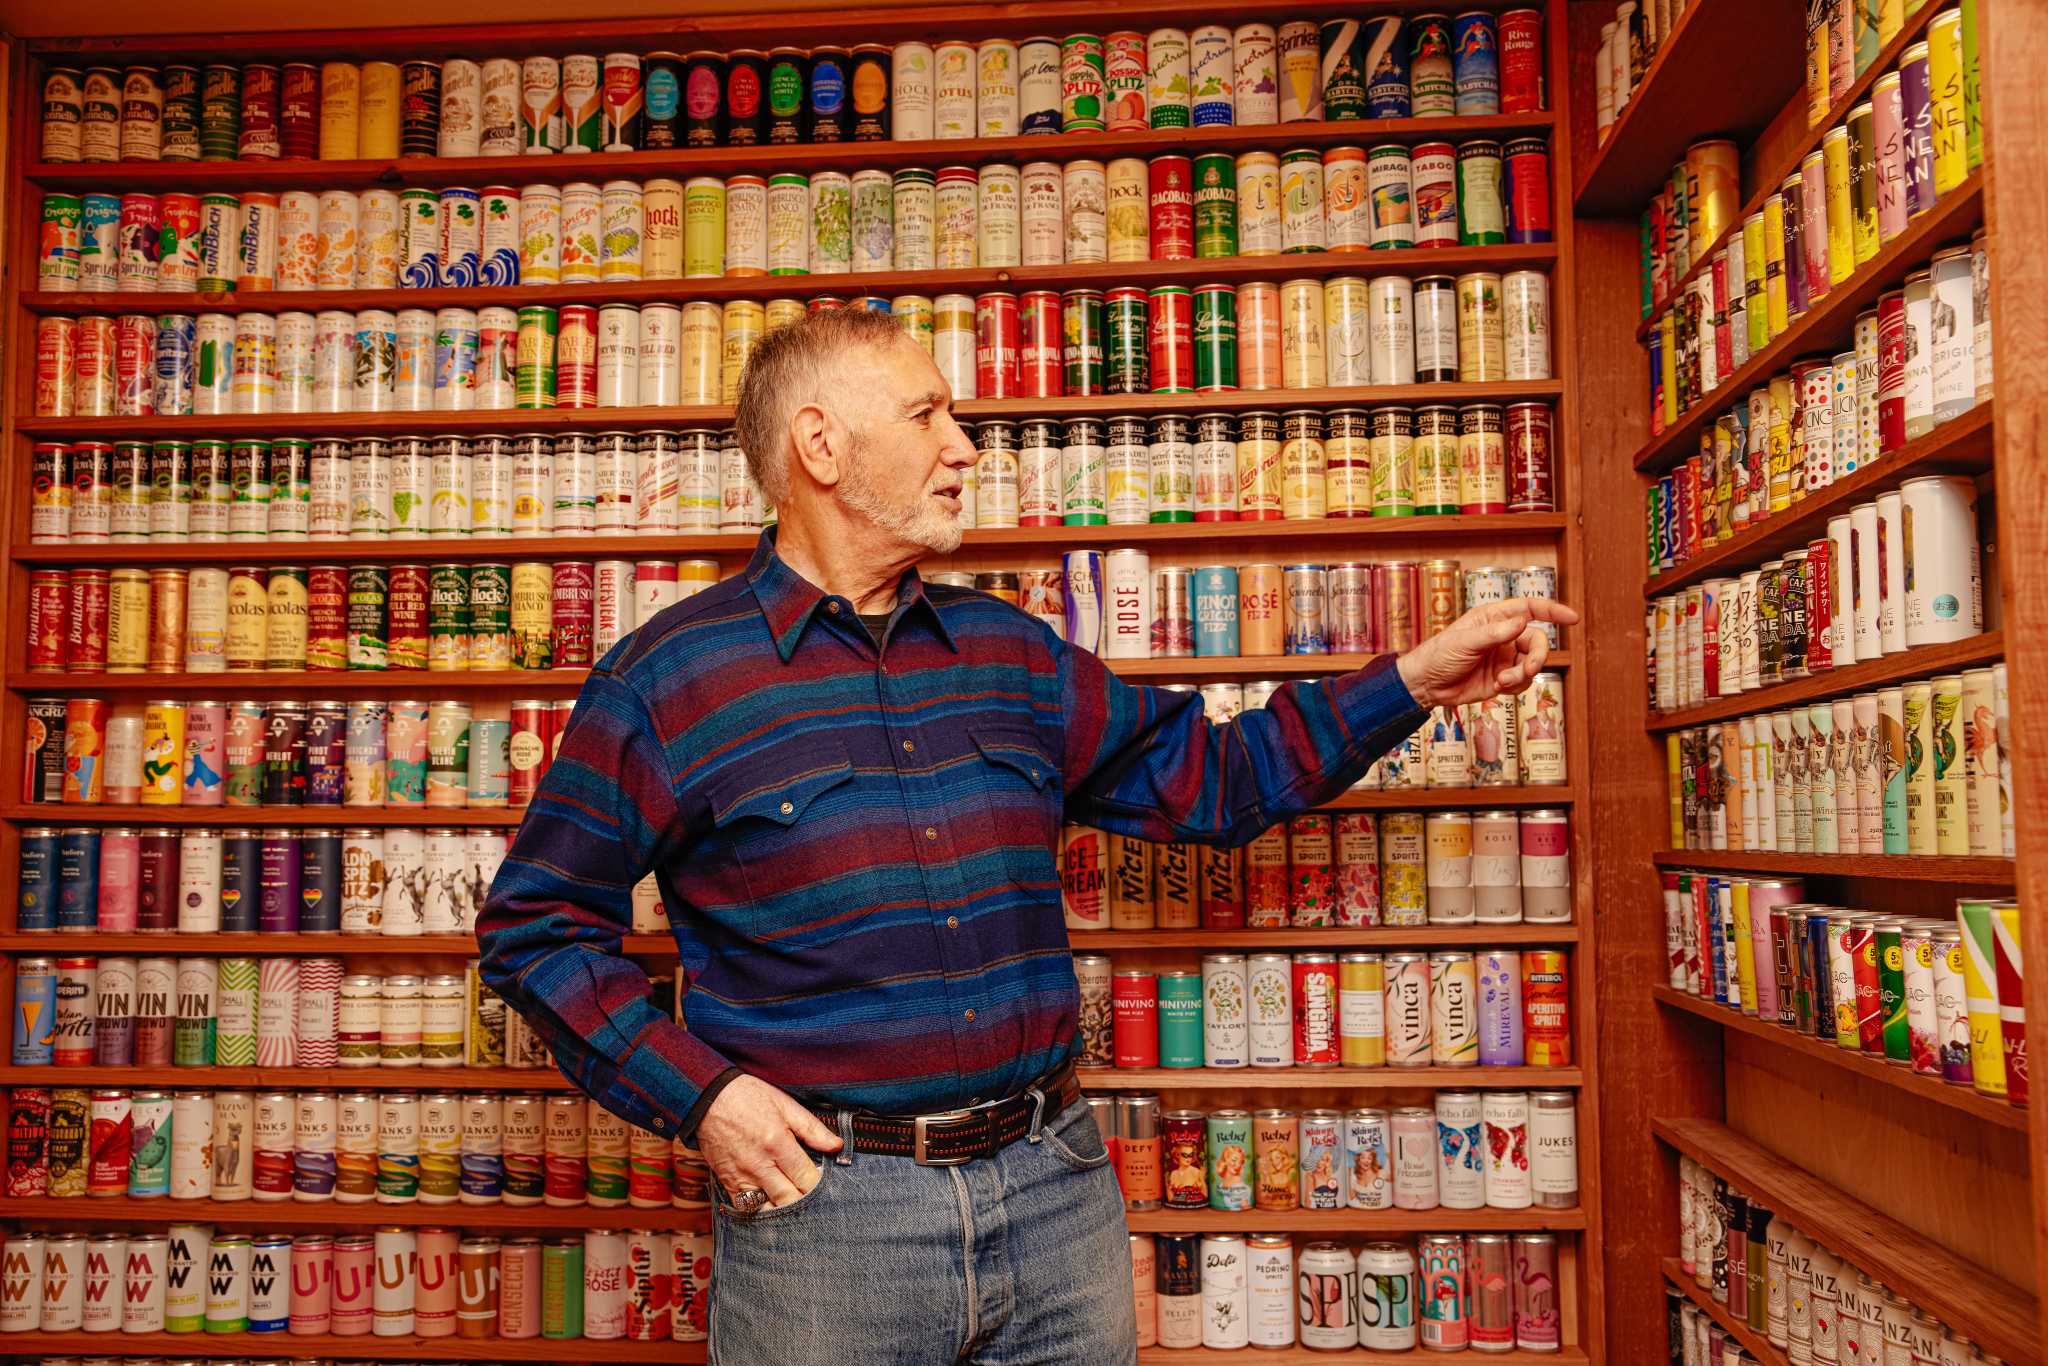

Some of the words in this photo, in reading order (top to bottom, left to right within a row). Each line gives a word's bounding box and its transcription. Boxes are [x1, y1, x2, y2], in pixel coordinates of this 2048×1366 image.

[1508, 30, 1531, 40] Rive
[599, 569, 616, 630] BEEFSTEAK
[1242, 588, 1278, 609] ROSÉ
[1480, 591, 1500, 599] VIN
[1523, 590, 1544, 598] VIN
[1113, 586, 1140, 635] ROSÉ
[1505, 702, 1515, 759] SPRITZER
[96, 993, 129, 1016] VIN
[136, 993, 168, 1016] VIN
[177, 994, 209, 1016] VIN
[1401, 982, 1418, 1042] vinca
[1445, 982, 1463, 1041] vinca
[1125, 1144, 1153, 1153] DEFY
[1538, 1137, 1575, 1146] JUKES
